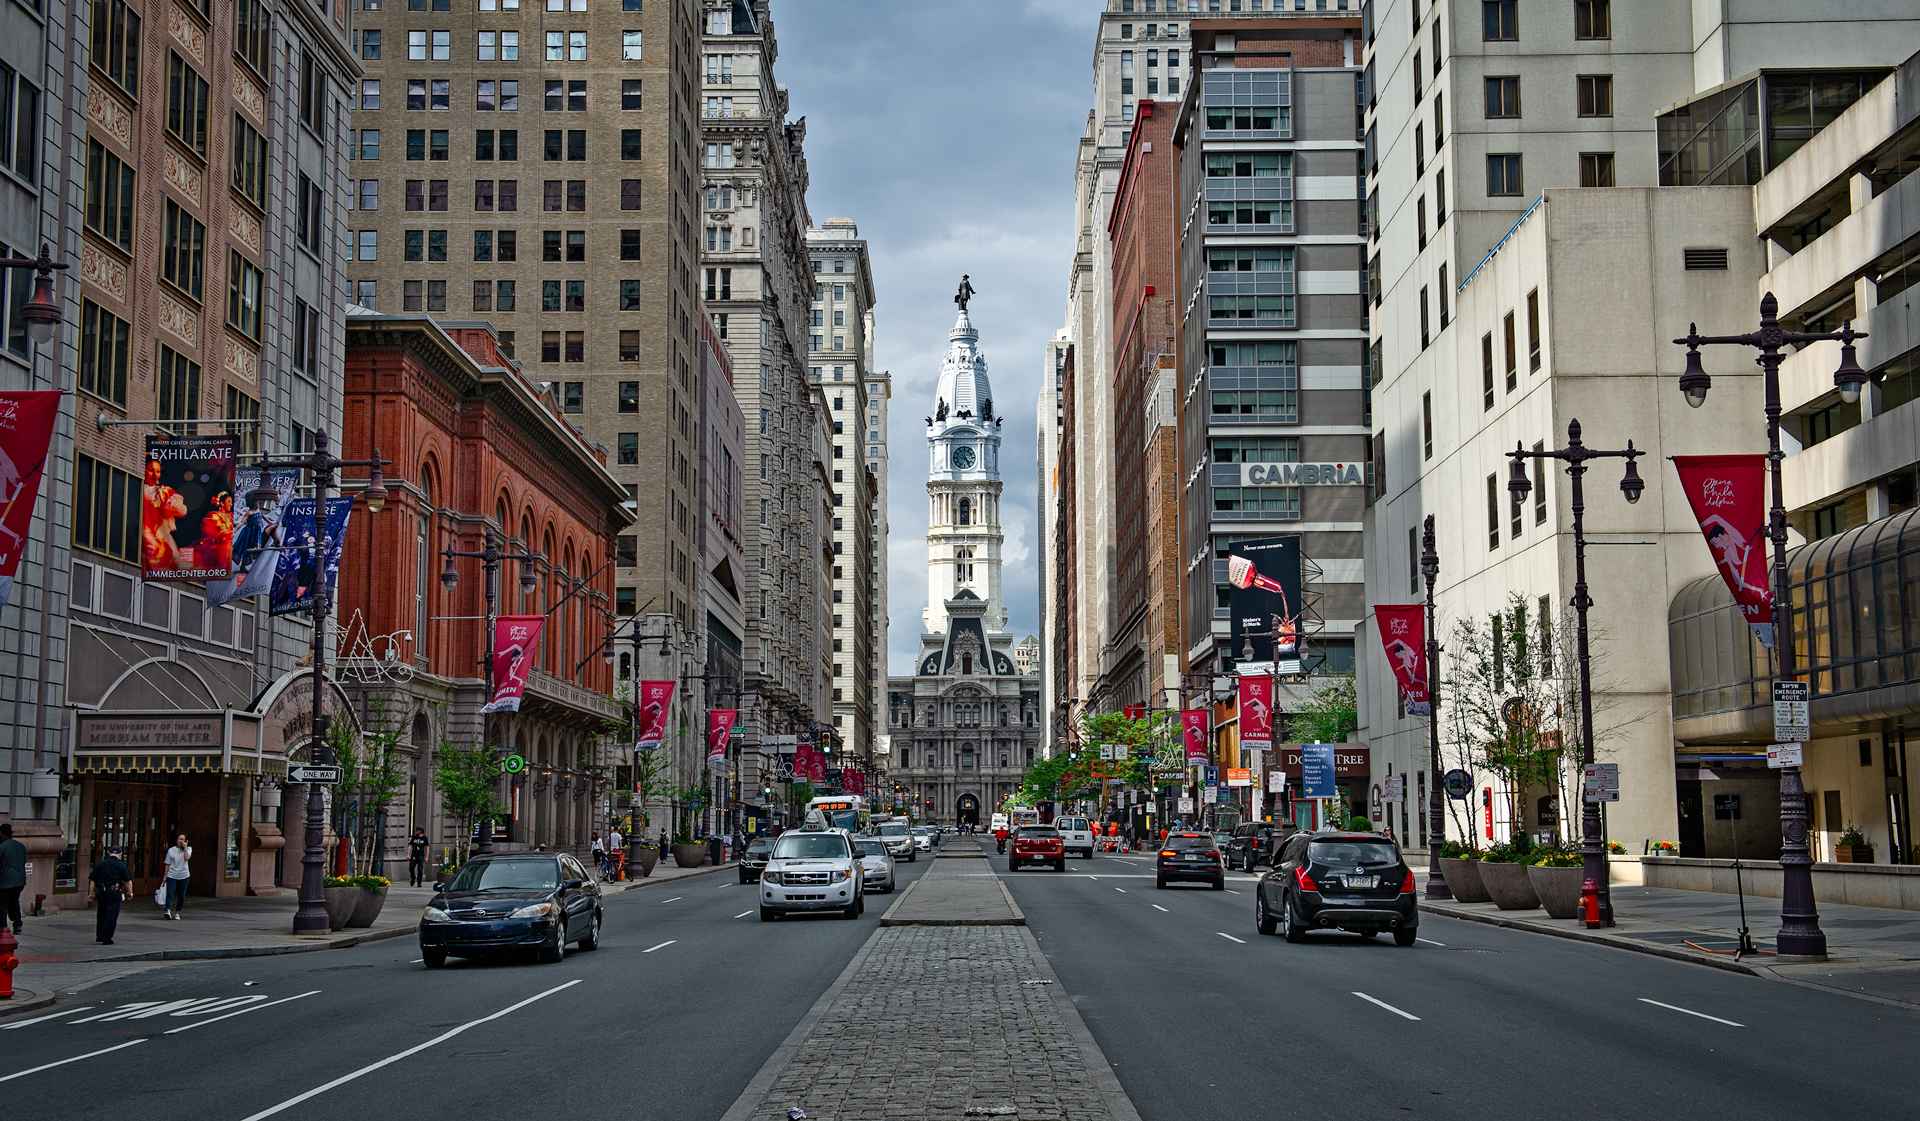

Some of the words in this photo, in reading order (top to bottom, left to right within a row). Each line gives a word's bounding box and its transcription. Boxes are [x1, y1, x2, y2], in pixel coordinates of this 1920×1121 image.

[151, 447, 232, 460] EXHILARATE
[1703, 477, 1733, 489] Opera
[1703, 484, 1735, 499] Phila
[1705, 496, 1736, 507] delphia
[90, 733, 150, 743] MERRIAM
[154, 733, 210, 743] THEATER
[1207, 771, 1216, 779] H
